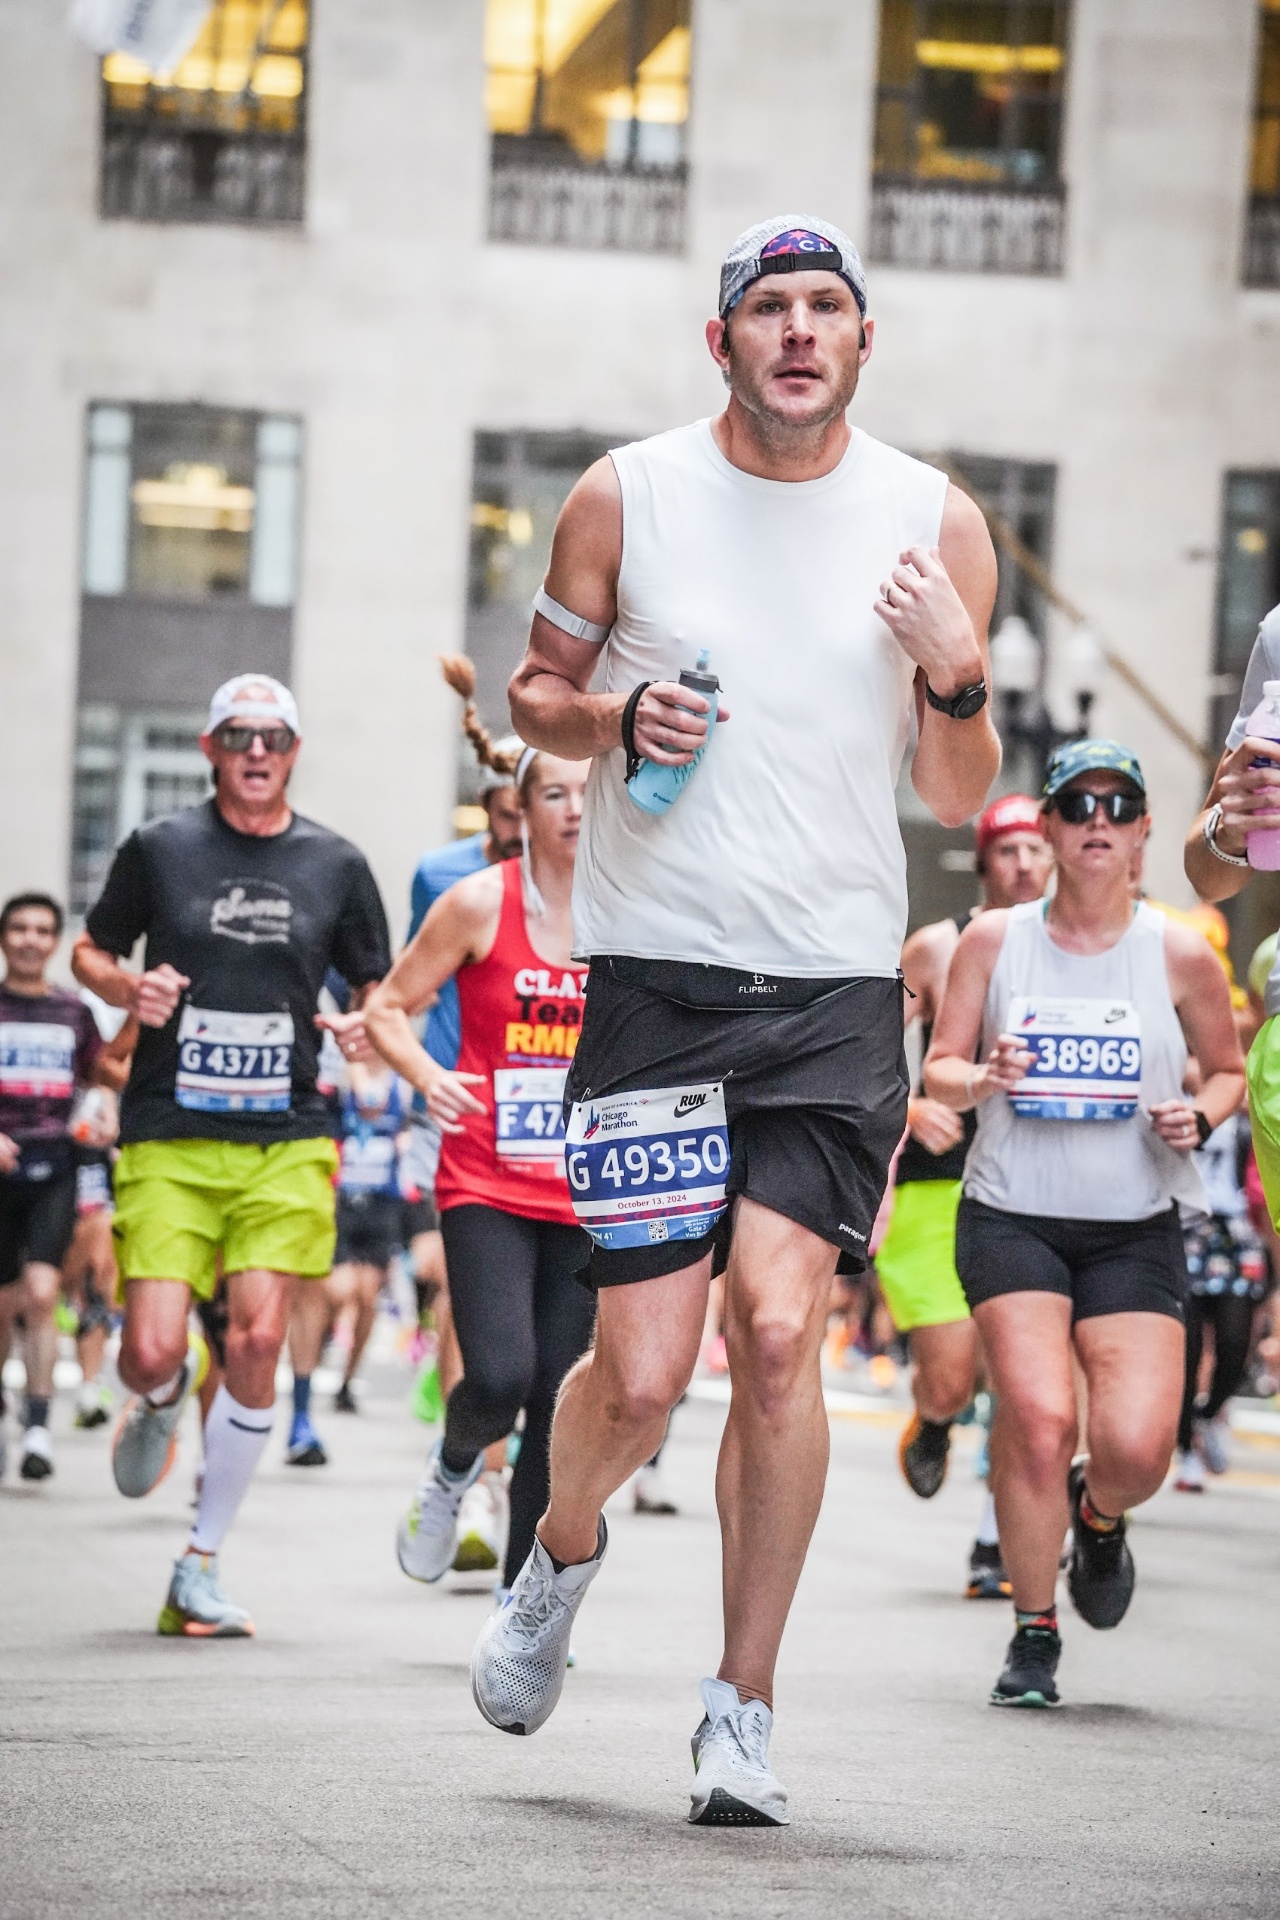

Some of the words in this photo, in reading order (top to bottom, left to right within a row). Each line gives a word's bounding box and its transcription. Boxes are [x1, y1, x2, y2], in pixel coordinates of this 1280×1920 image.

[738, 985, 778, 994] FLIPBELT
[181, 1041, 202, 1072] G
[206, 1045, 290, 1076] 43712
[1036, 1037, 1140, 1076] 38969
[679, 1093, 707, 1107] RUN
[498, 1103, 520, 1137] F
[524, 1103, 566, 1137] 47
[601, 1111, 628, 1122] Chicago
[601, 1120, 638, 1132] Marathon
[568, 1151, 591, 1191] G
[601, 1134, 728, 1188] 49350
[617, 1200, 650, 1209] October
[652, 1197, 665, 1205] 13,
[666, 1194, 687, 1203] 2024
[603, 1232, 613, 1241] 41
